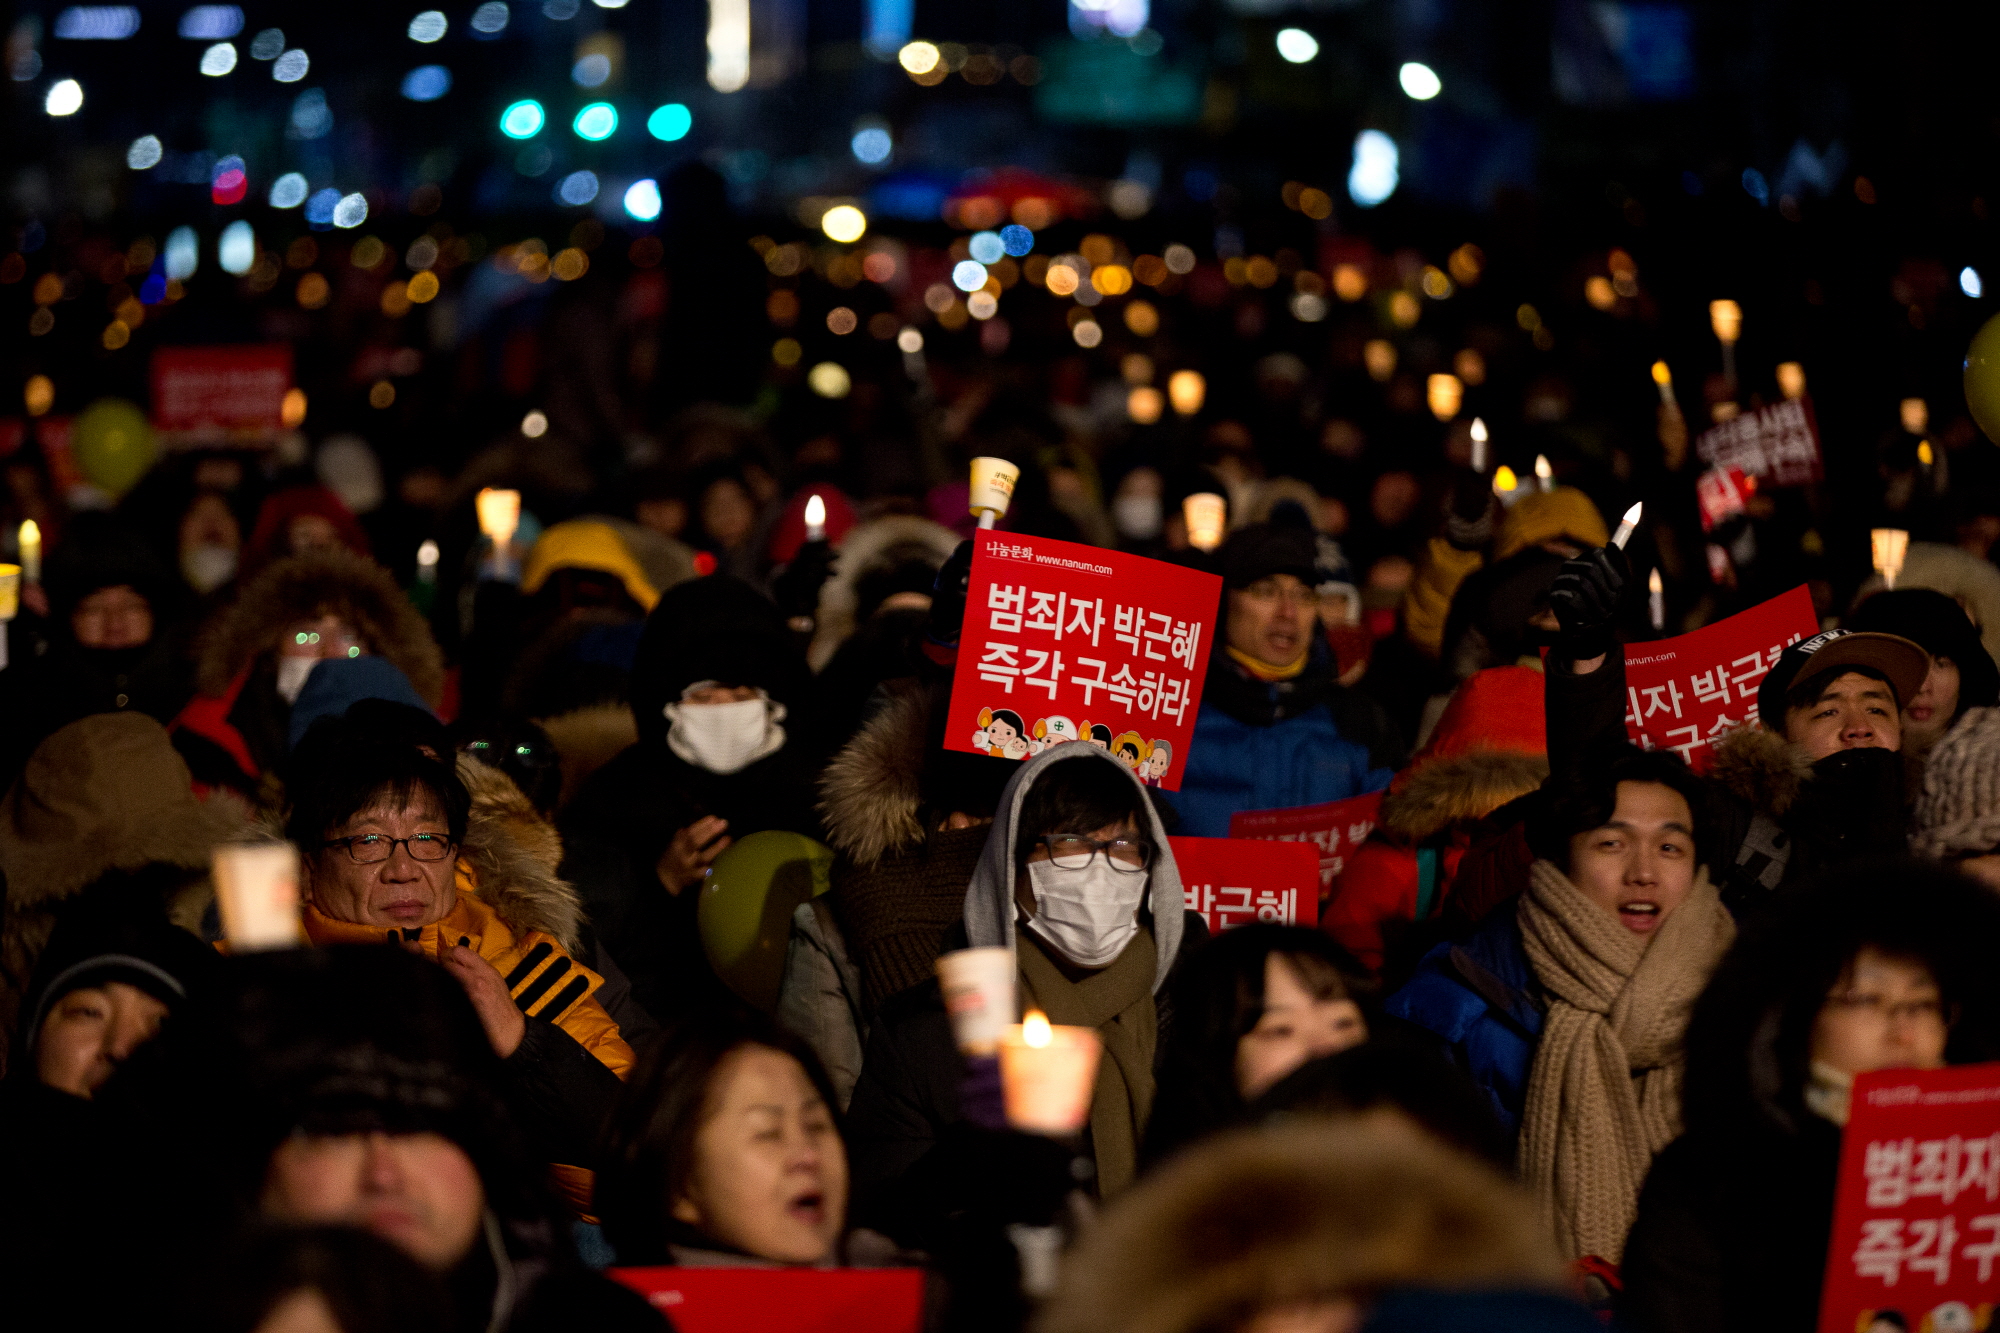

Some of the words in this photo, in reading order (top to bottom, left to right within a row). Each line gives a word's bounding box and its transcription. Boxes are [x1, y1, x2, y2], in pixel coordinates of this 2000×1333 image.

[986, 541, 1034, 561] 나눔문화
[1035, 555, 1113, 575] www.nanum.com
[988, 582, 1106, 647] 범죄자
[1113, 604, 1202, 671] 박근혜
[977, 641, 1065, 700] 즉각
[1071, 656, 1191, 726] 구속하라
[1184, 884, 1298, 929] 박근혜
[1863, 1132, 2000, 1209] 범죄자
[1851, 1214, 1960, 1288] 즉각
